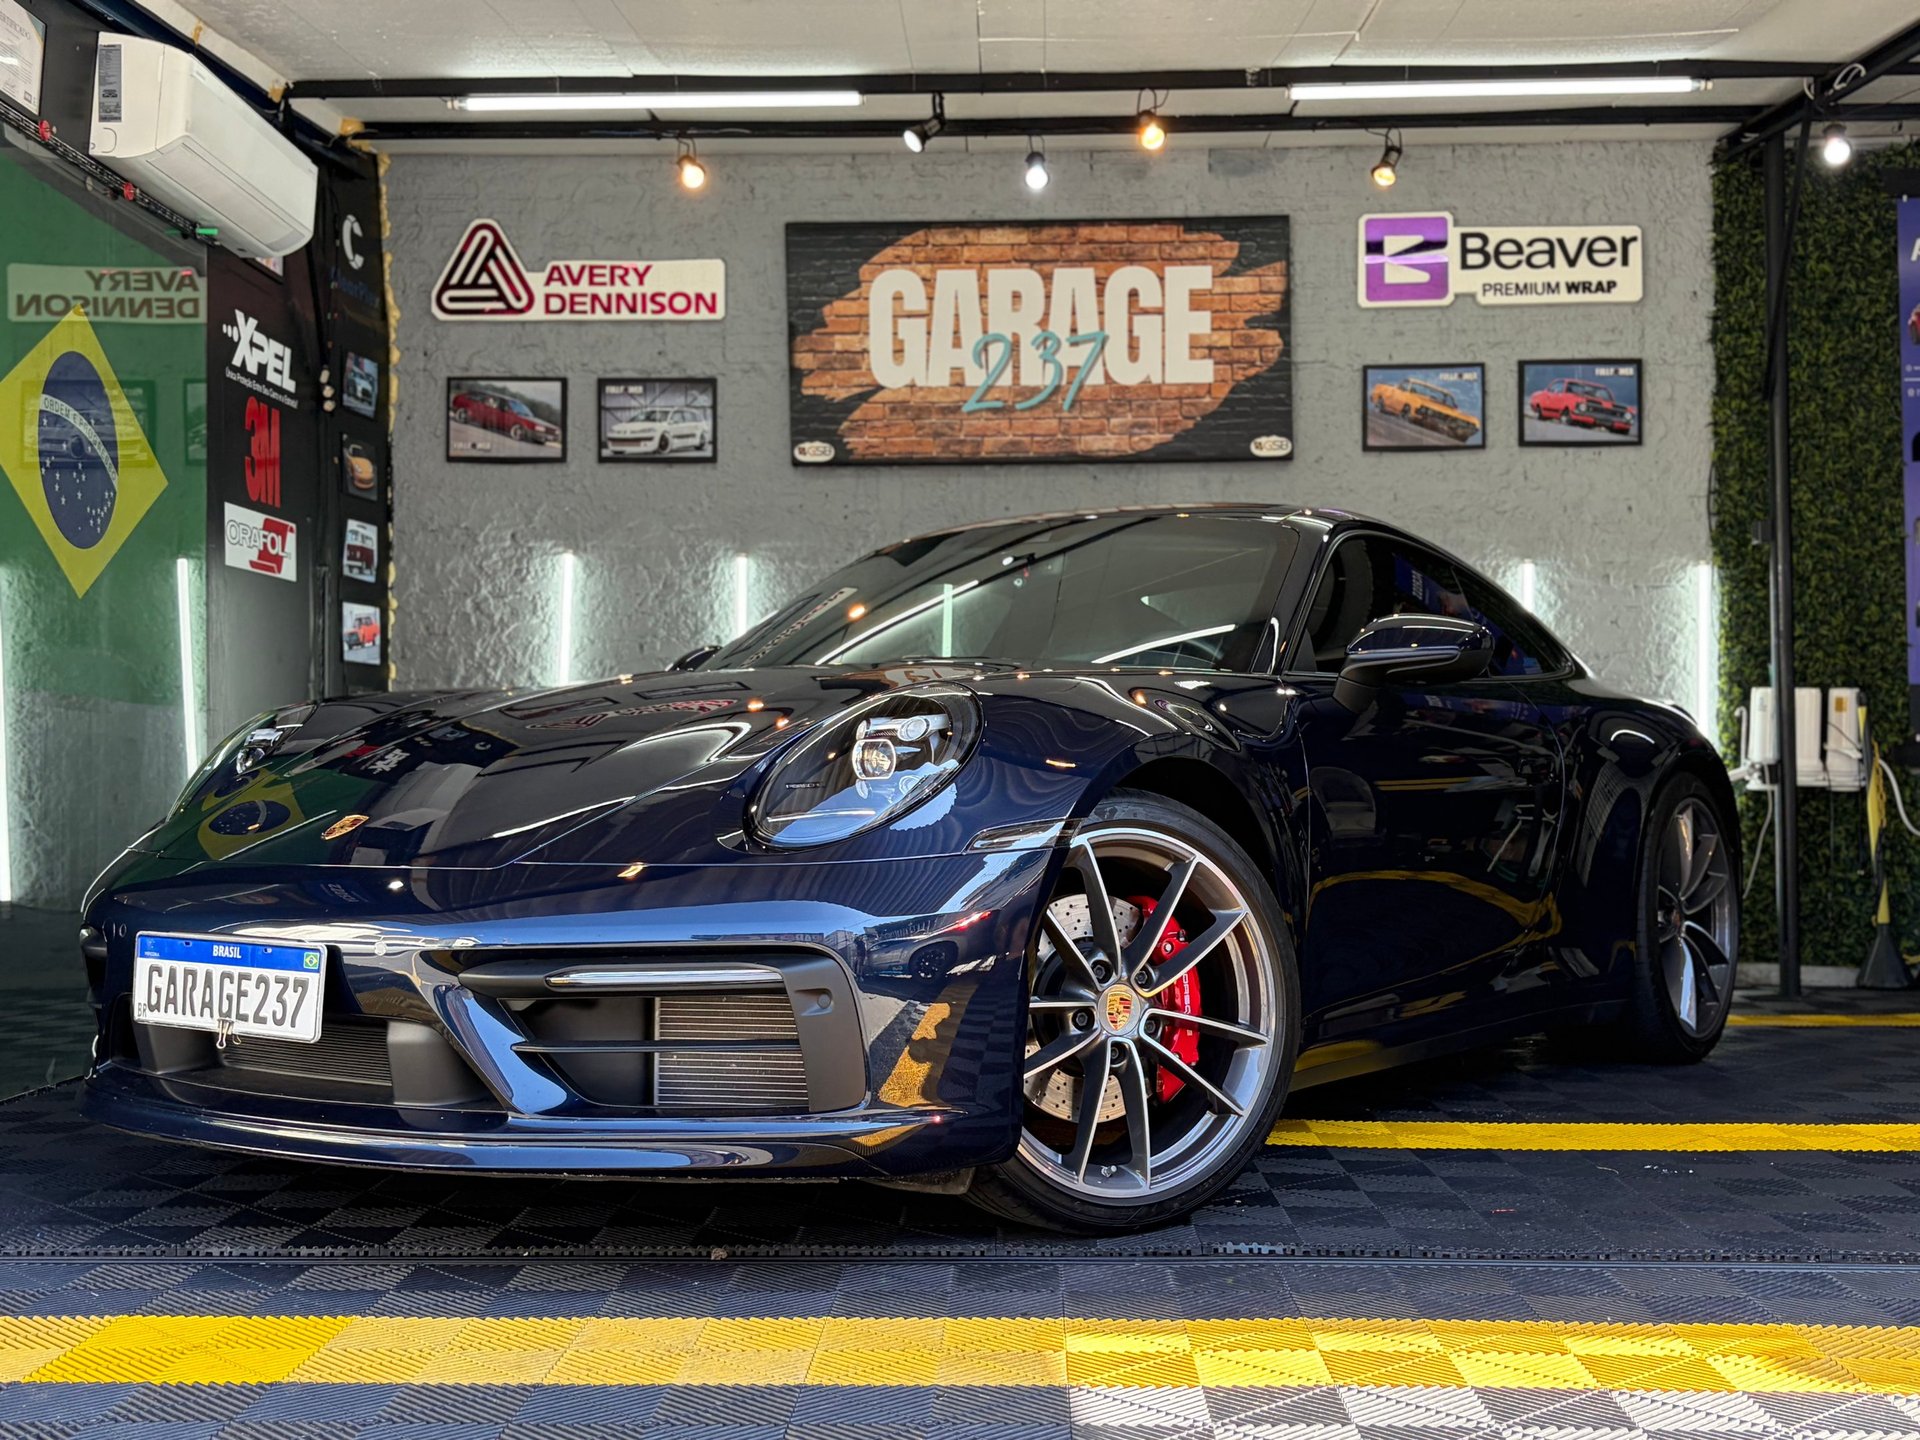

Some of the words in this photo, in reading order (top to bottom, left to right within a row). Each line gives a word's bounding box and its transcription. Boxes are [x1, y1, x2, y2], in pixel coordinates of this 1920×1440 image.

[1460, 232, 1638, 270] Beaver
[544, 265, 653, 286] AVERY
[1482, 282, 1560, 297] PREMIUM
[1565, 280, 1617, 294] WRAP
[544, 292, 717, 315] DENNISON
[868, 265, 1214, 389] GARAGE
[231, 308, 296, 394] XPEL
[961, 331, 1109, 413] 237
[44, 398, 71, 417] ORDEM
[245, 396, 281, 508] 3M
[226, 519, 287, 557] ORAFOL
[212, 944, 241, 959] BRASIL
[137, 1002, 147, 1018] BR
[147, 963, 309, 1029] GARAGE237
